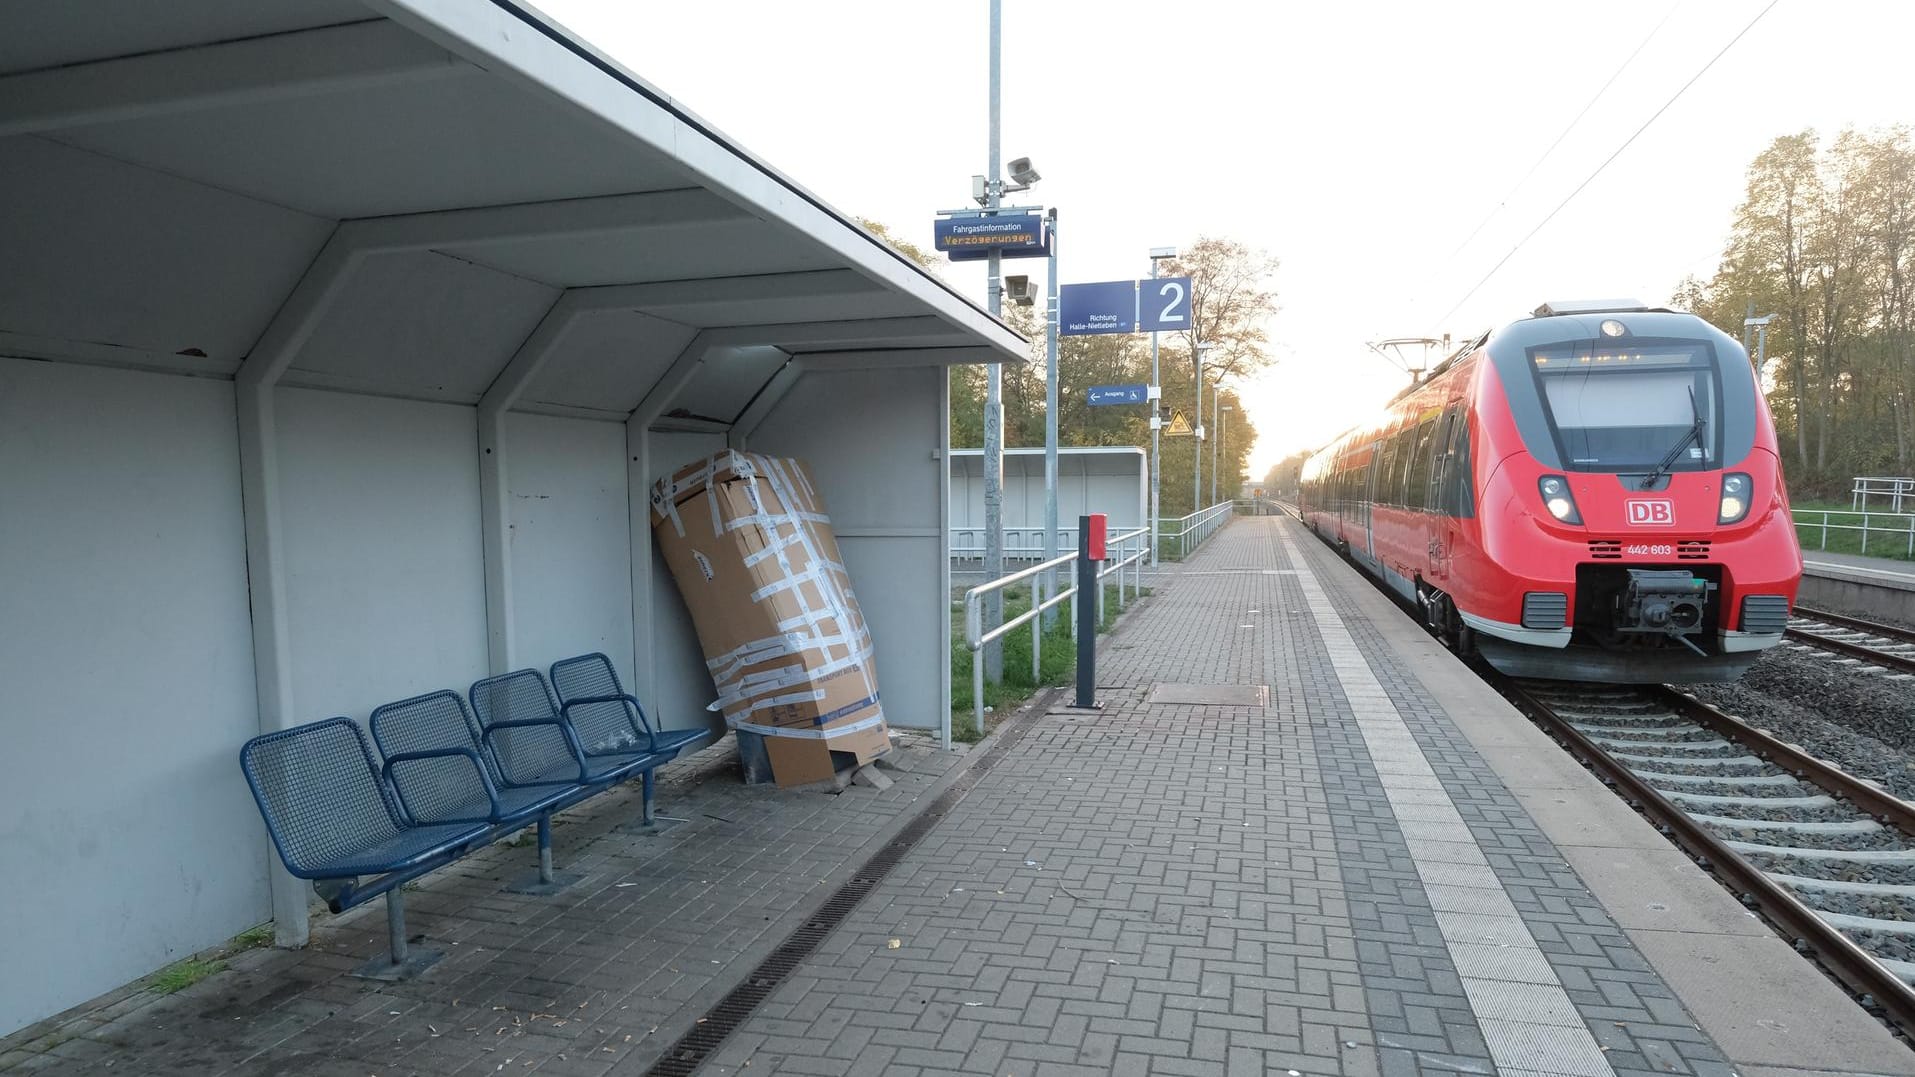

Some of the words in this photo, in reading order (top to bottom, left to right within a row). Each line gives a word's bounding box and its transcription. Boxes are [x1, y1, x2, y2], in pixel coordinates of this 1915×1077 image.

[953, 223, 1022, 234] Fahrgastinformation
[944, 234, 1032, 245] Verzögerungen
[1159, 282, 1184, 322] 2
[1089, 314, 1118, 322] Richtung
[1630, 502, 1671, 522] DB
[1628, 544, 1649, 555] 442
[1651, 544, 1671, 555] 603
